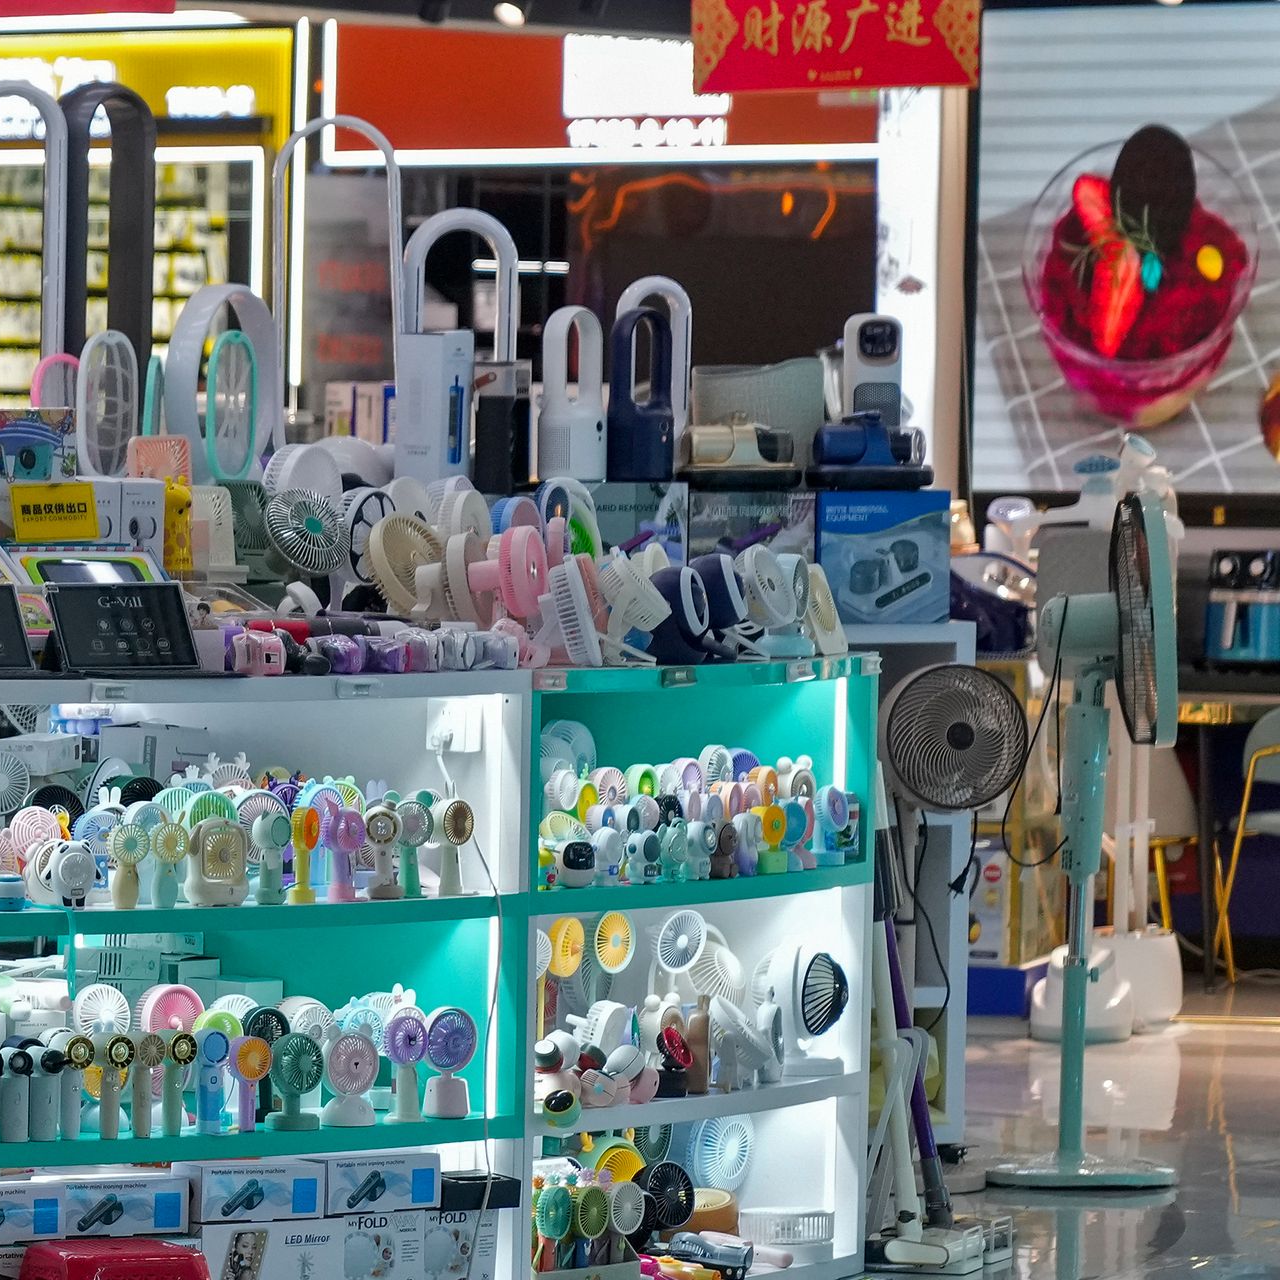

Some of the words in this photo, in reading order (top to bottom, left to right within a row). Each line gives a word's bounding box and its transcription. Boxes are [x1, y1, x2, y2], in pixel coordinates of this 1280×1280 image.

[742, 0, 932, 55] 财源广进
[21, 503, 88, 516] 商品仅供出口
[358, 1216, 388, 1230] FOLD
[439, 1212, 467, 1224] FOLD
[285, 1235, 303, 1245] LED
[304, 1234, 330, 1244] Mirror
